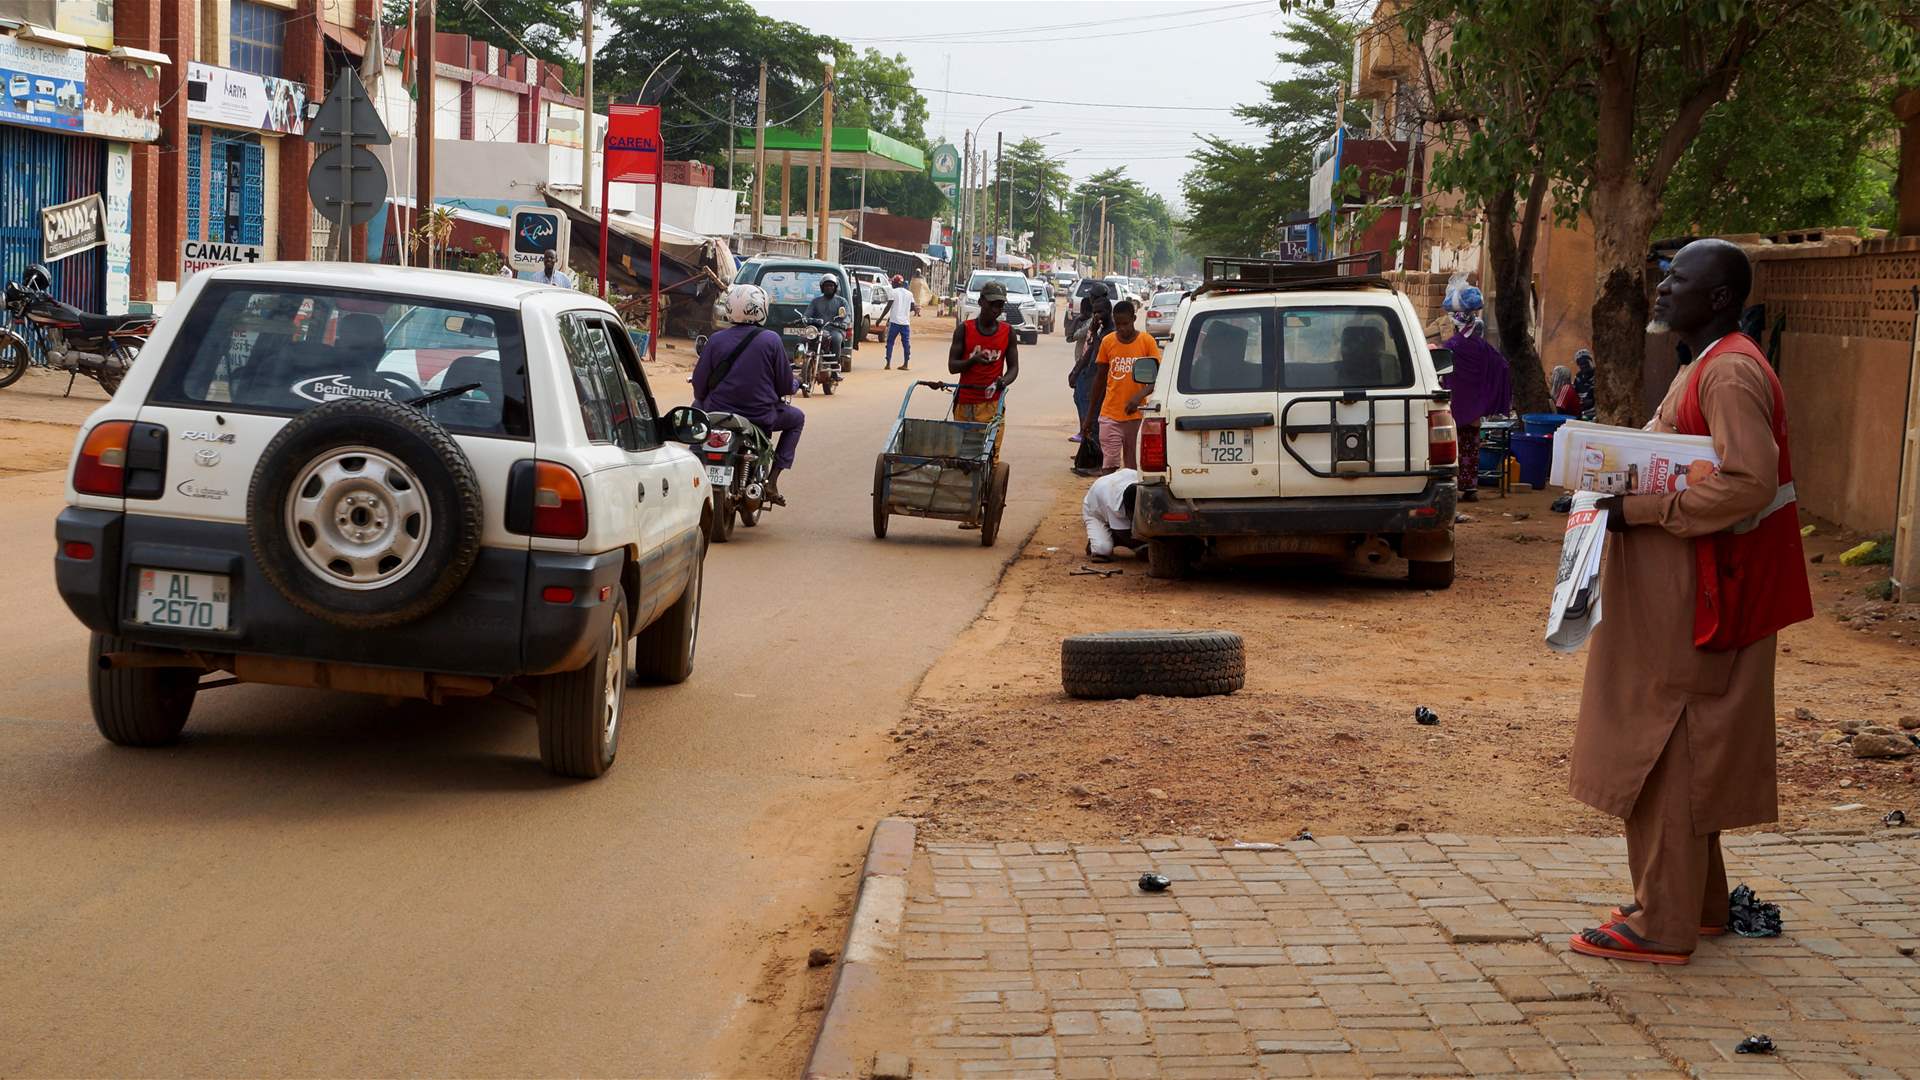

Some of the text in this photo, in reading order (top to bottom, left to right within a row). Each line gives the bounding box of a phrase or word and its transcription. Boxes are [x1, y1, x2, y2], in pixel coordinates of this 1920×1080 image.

[314, 382, 392, 400] Benchmark
[181, 431, 236, 444] RAV4
[1219, 431, 1235, 445] AD
[1211, 447, 1243, 462] 7292
[168, 575, 198, 600] AL
[152, 598, 213, 627] 2670
